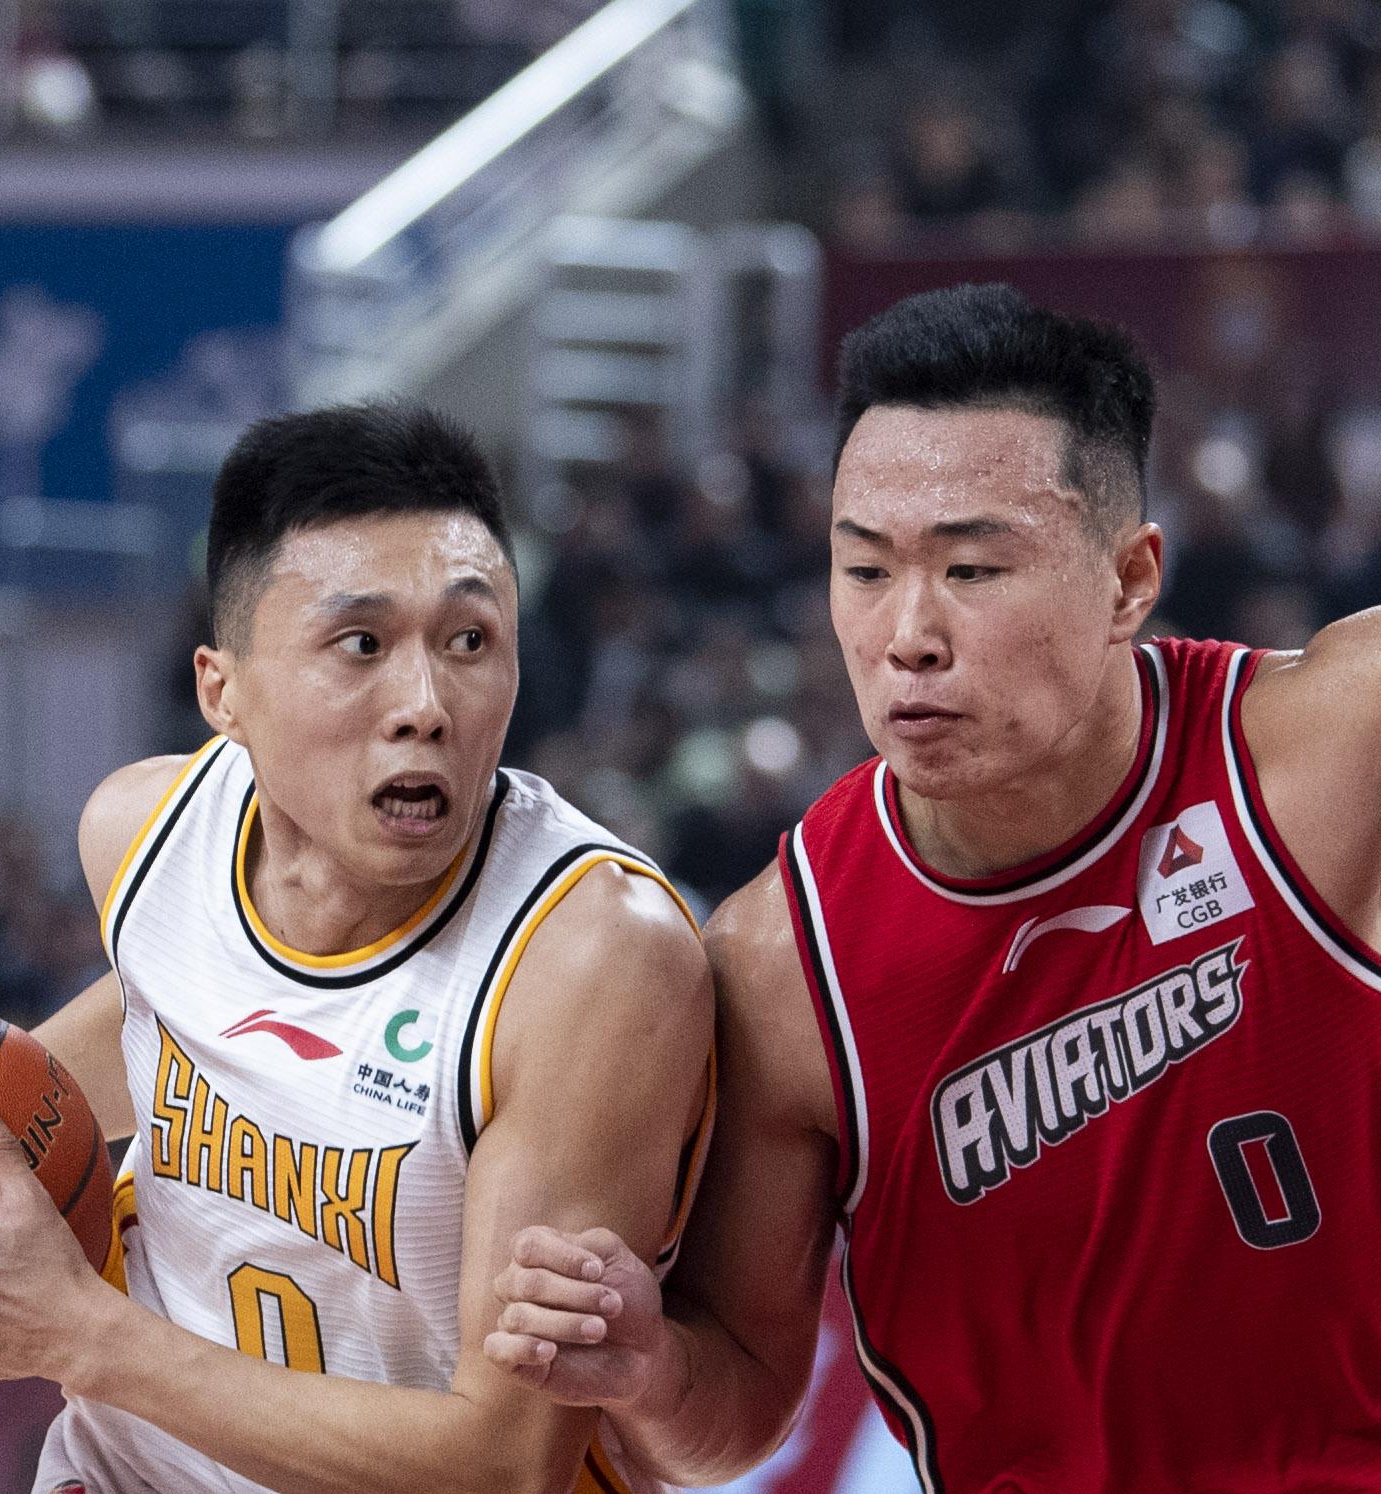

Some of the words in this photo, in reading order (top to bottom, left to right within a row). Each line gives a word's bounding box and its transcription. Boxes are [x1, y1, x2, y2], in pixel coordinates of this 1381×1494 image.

[1156, 871, 1228, 914] 广发银行
[1176, 899, 1223, 929] CGB
[357, 1063, 431, 1102] 中国人寿
[931, 934, 1252, 1205] AVIATORS
[353, 1083, 393, 1105] CHINA
[396, 1098, 427, 1117] LIFE
[151, 1012, 421, 1292] SHANXI
[1207, 1111, 1322, 1251] 0
